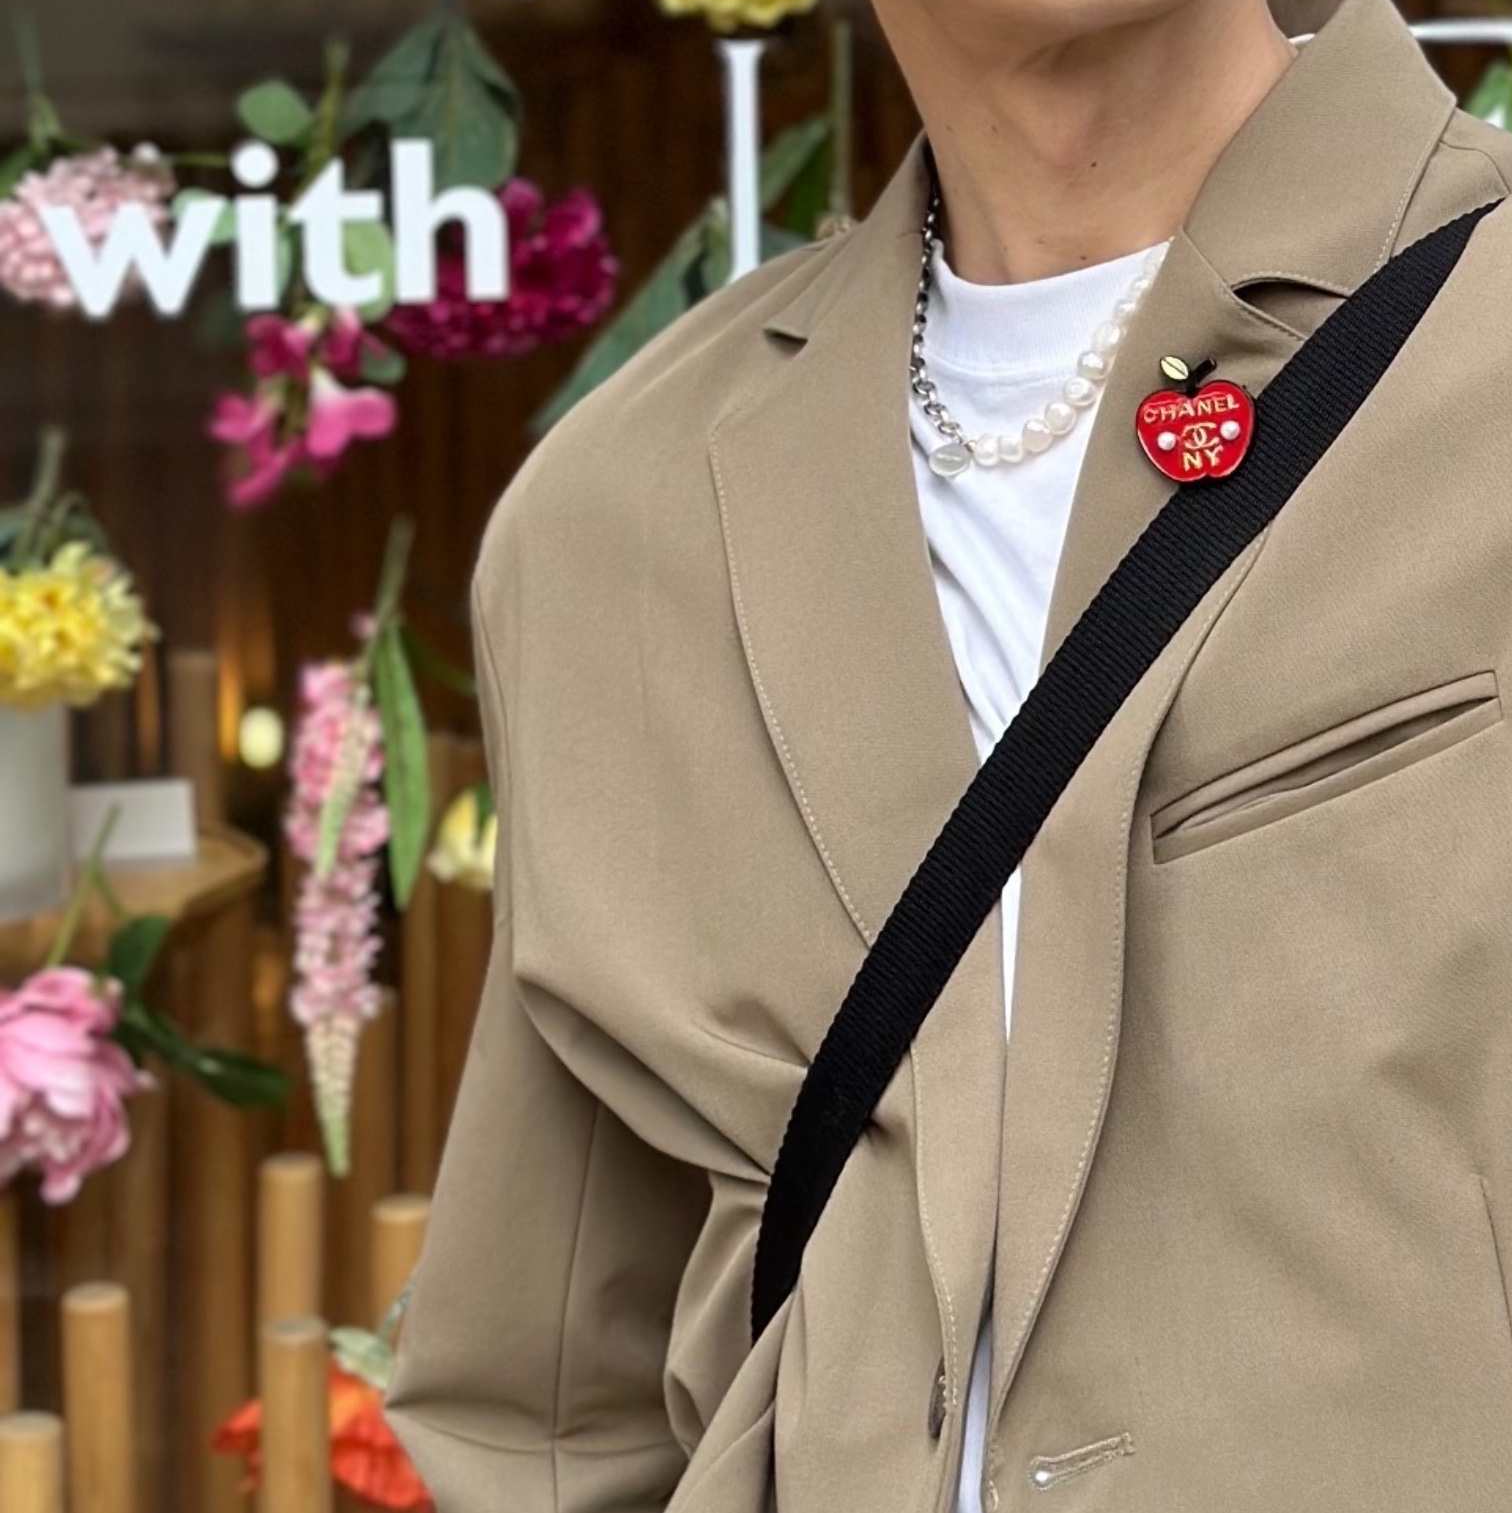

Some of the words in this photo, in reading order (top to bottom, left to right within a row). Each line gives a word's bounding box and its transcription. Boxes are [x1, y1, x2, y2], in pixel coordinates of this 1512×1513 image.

[40, 138, 511, 320] with
[1143, 393, 1240, 424] CHANEL
[1182, 444, 1225, 472] NY
